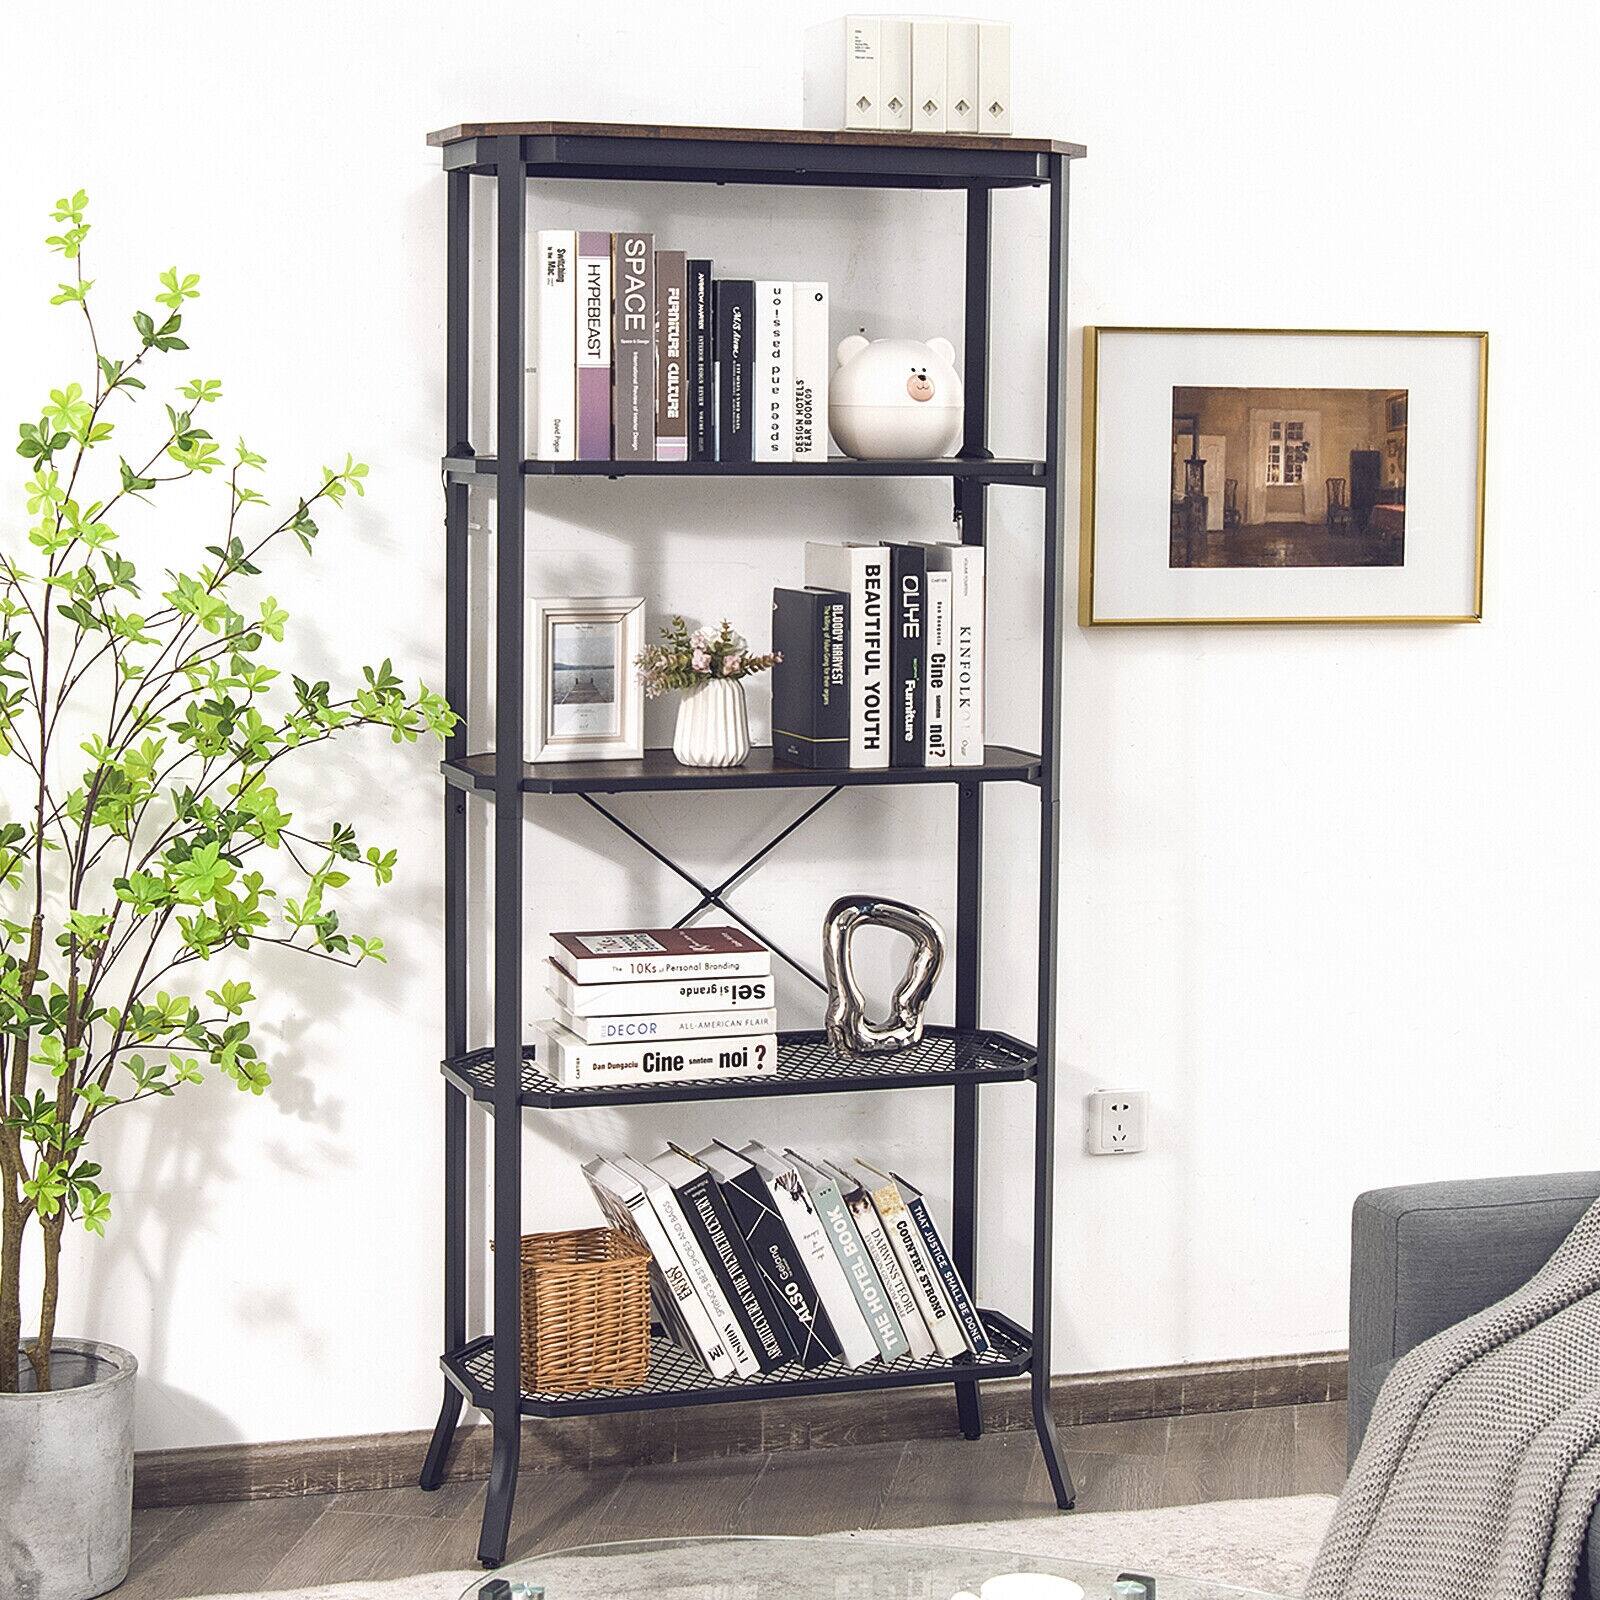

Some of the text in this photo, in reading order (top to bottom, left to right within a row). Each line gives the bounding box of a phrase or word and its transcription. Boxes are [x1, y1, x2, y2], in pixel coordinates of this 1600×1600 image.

[547, 261, 556, 276] Mac
[556, 248, 566, 282] Switching
[624, 238, 646, 330] SPACE
[588, 264, 601, 359] HYPEBEAST
[667, 287, 680, 418] FURNITURE CULTURE
[770, 288, 782, 451] speed and passion
[796, 380, 804, 452] DESIGN HOTELS
[804, 388, 812, 424] BOOK09
[554, 419, 562, 435] David
[832, 604, 843, 685] BLOODY HARVEST
[864, 564, 881, 750] BEAUTIFUL YOUTH
[931, 653, 946, 688] Cine
[959, 626, 971, 708] KINFOLK
[905, 680, 916, 742] Furniture
[630, 963, 657, 974] 10Ks
[666, 963, 702, 972] Personal
[704, 962, 740, 971] Branding
[680, 984, 717, 997] grande
[731, 984, 766, 1005] sei
[608, 1022, 657, 1036] DECOR
[679, 1018, 769, 1030] ALL-AMERICAN FLAIR
[642, 1052, 684, 1072] Cine
[694, 1195, 722, 1234] CENTURY
[711, 1231, 743, 1279] TWENTIETH
[769, 1244, 788, 1280] Gelang
[871, 1228, 915, 1315] DARWINS TEORI
[896, 1220, 946, 1319] COUNTRY STRONG
[914, 1206, 982, 1343] THAT JUSTICE SHALL BE DONE
[669, 1264, 692, 1298] ENJOY
[732, 1275, 751, 1294] THE
[827, 1204, 898, 1351] THE HOTEL BOOK
[785, 1282, 813, 1323] ALSO
[723, 1323, 748, 1363] FASHION
